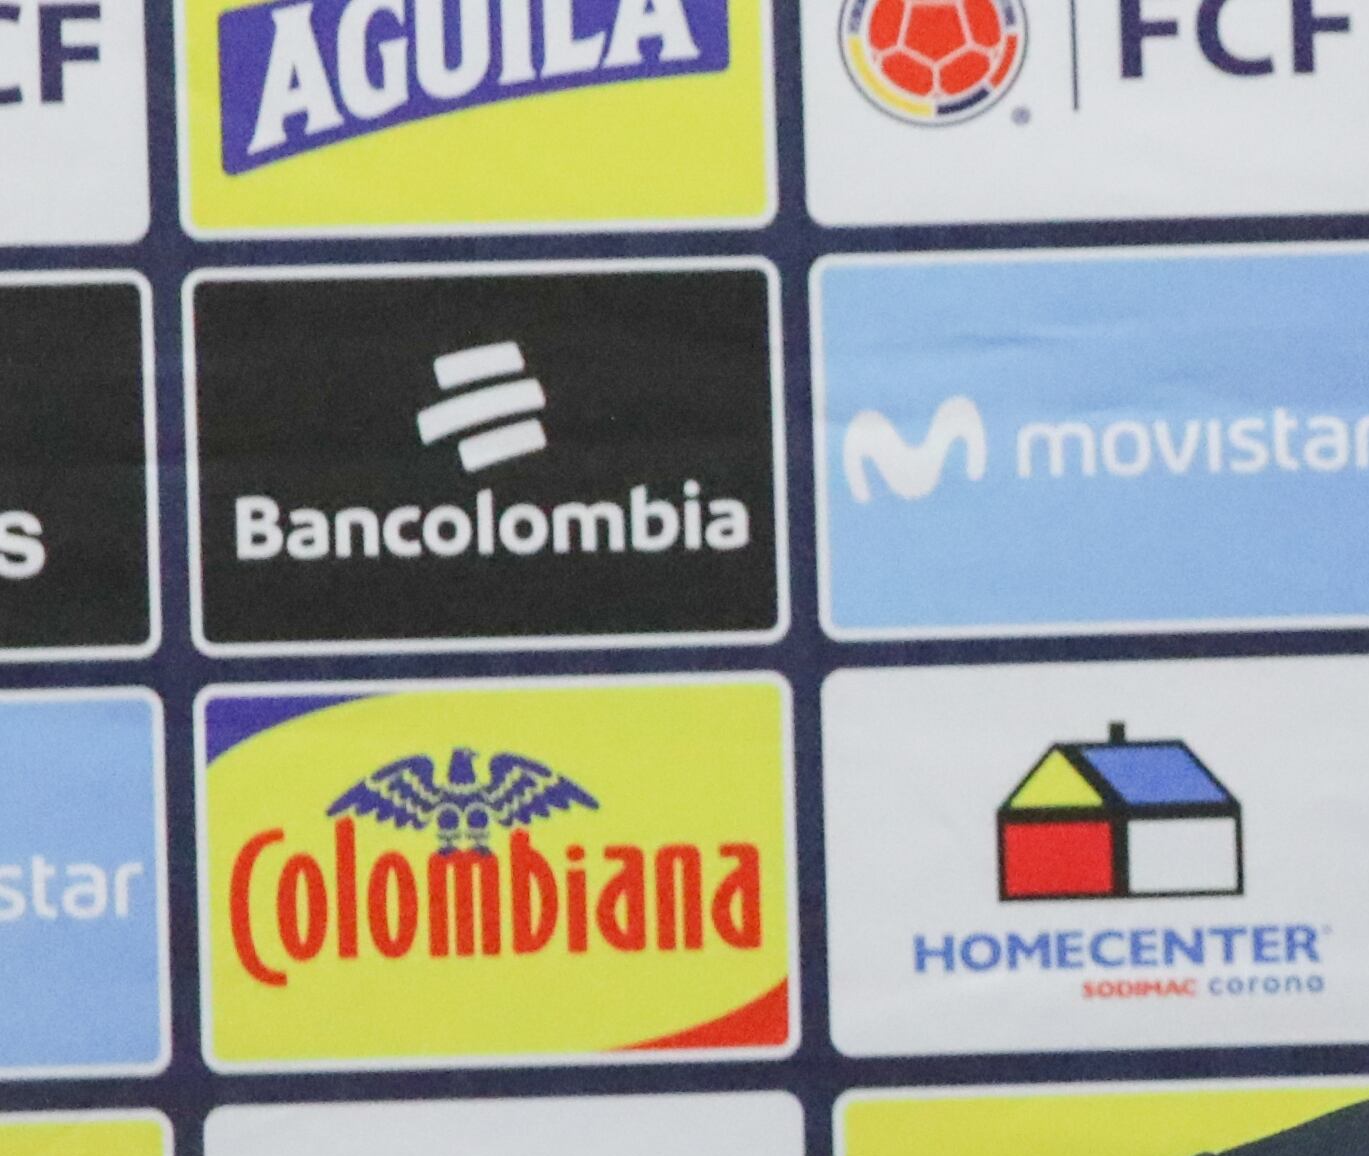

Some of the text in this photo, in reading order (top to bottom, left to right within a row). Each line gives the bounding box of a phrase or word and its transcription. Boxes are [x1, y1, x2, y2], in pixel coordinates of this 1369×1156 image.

[1120, 0, 1350, 78] FCF
[236, 480, 749, 560] Bancolombia
[0, 855, 143, 919] star
[229, 817, 762, 987] Colombiana
[914, 924, 1320, 973] HOMECENTER
[1082, 977, 1197, 999] SODIMAC
